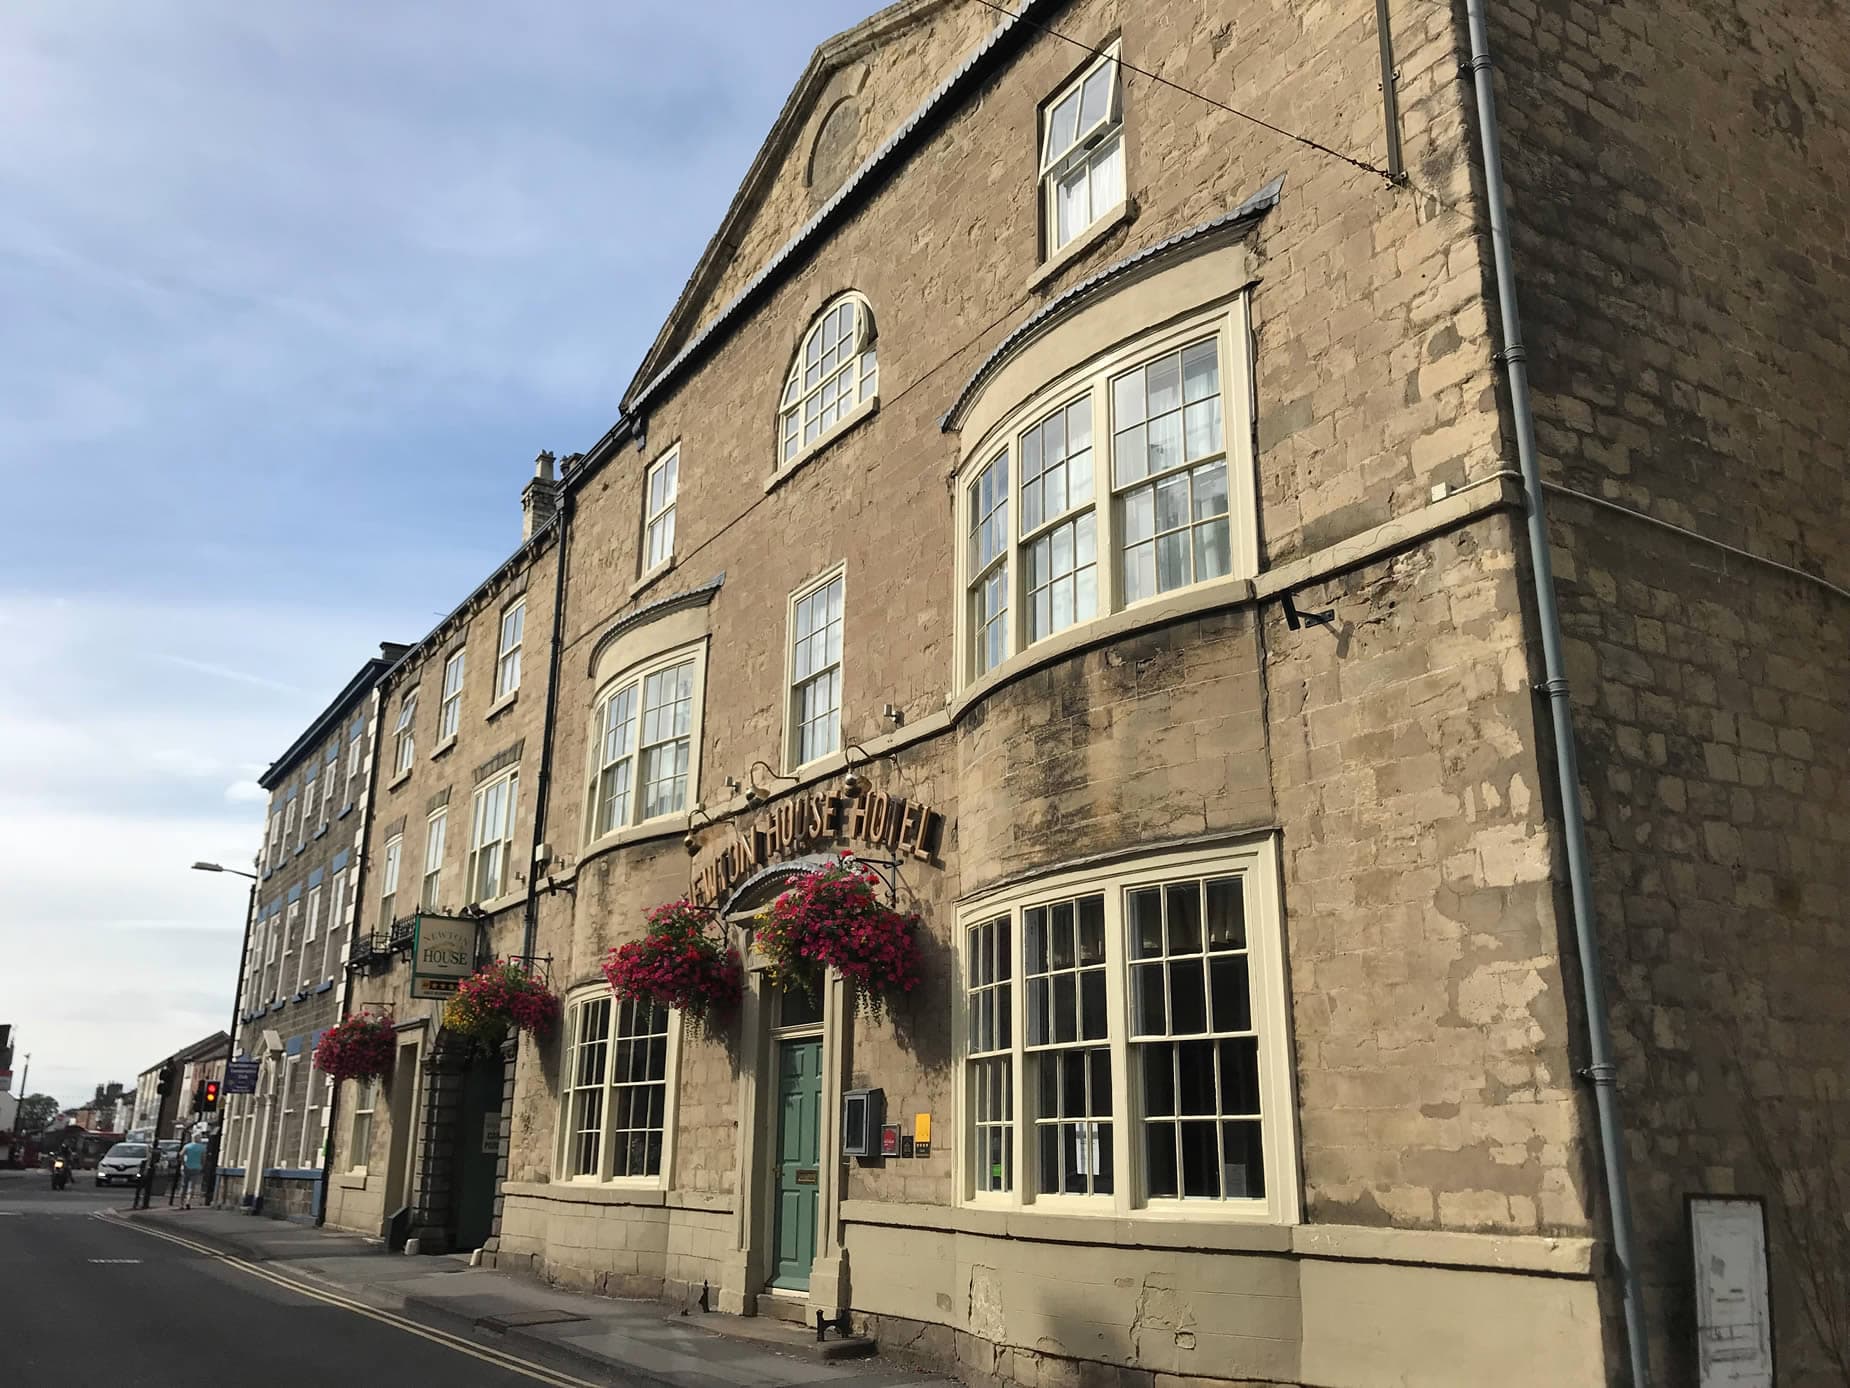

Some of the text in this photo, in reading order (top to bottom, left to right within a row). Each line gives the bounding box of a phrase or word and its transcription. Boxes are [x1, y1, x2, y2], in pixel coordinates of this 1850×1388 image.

[767, 790, 841, 857] HOUSE
[851, 791, 931, 864] HOTEL
[423, 928, 469, 946] NEWTON
[423, 948, 468, 966] HOUSE
